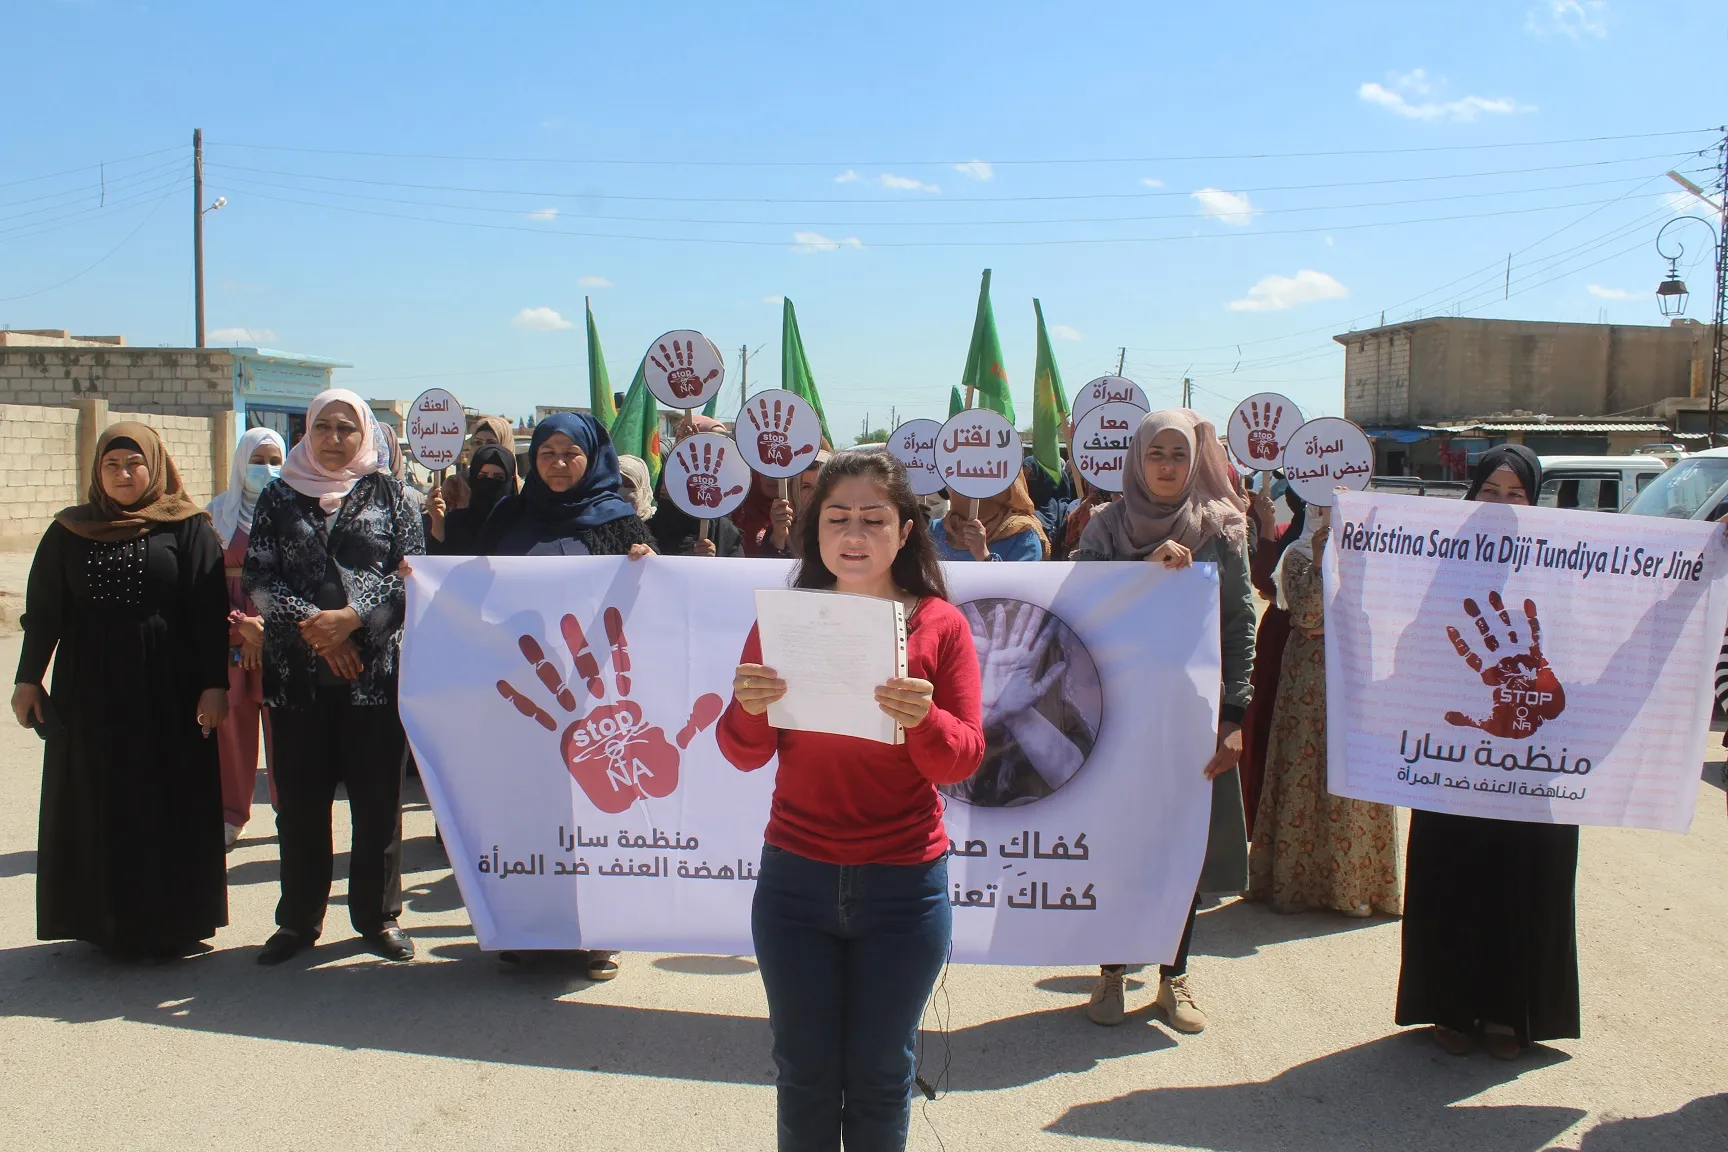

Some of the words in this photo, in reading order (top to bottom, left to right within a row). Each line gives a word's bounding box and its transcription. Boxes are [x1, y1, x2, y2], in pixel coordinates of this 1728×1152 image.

[671, 370, 692, 379] stop
[679, 383, 694, 393] NA
[1093, 379, 1133, 402] المرأة
[419, 396, 449, 412] العنف
[411, 416, 438, 440] المرأة
[440, 422, 459, 435] ضد
[763, 433, 785, 443] stop
[1253, 431, 1273, 440] stop
[943, 424, 991, 453] لقتل
[996, 429, 1011, 449] لا
[1305, 436, 1344, 459] المرأة
[420, 446, 453, 463] جريمة
[767, 449, 783, 459] NA
[1256, 446, 1271, 454] NA
[944, 459, 1008, 479] النساء
[1287, 463, 1328, 483] الحياة
[1333, 460, 1370, 480] نبض
[692, 475, 714, 485] stop
[697, 491, 712, 501] NA
[1341, 521, 1424, 557] Rêxistina
[1427, 529, 1471, 561] Sara
[1475, 533, 1496, 562] Ya
[1497, 535, 1533, 573] Dijî
[1536, 538, 1608, 580] Tundiya
[1611, 545, 1630, 575] Li
[1630, 547, 1664, 578] Ser
[1663, 551, 1704, 582] Jinê
[1500, 689, 1553, 706] STOP
[572, 710, 634, 748] stop
[1400, 729, 1467, 765] سارا
[1474, 739, 1592, 776] منظمة
[606, 757, 654, 792] NA
[1397, 765, 1440, 786] المرأة
[1444, 774, 1470, 790] ضد
[1473, 777, 1516, 795] العنف
[1518, 782, 1586, 801] لمناهضة
[558, 825, 608, 853] سارا
[617, 827, 700, 850] منظمة
[478, 845, 544, 879] المرأة
[553, 857, 590, 876] ضد
[598, 856, 668, 878] العنف
[677, 858, 759, 881] ناهضة
[950, 882, 999, 908] تعن
